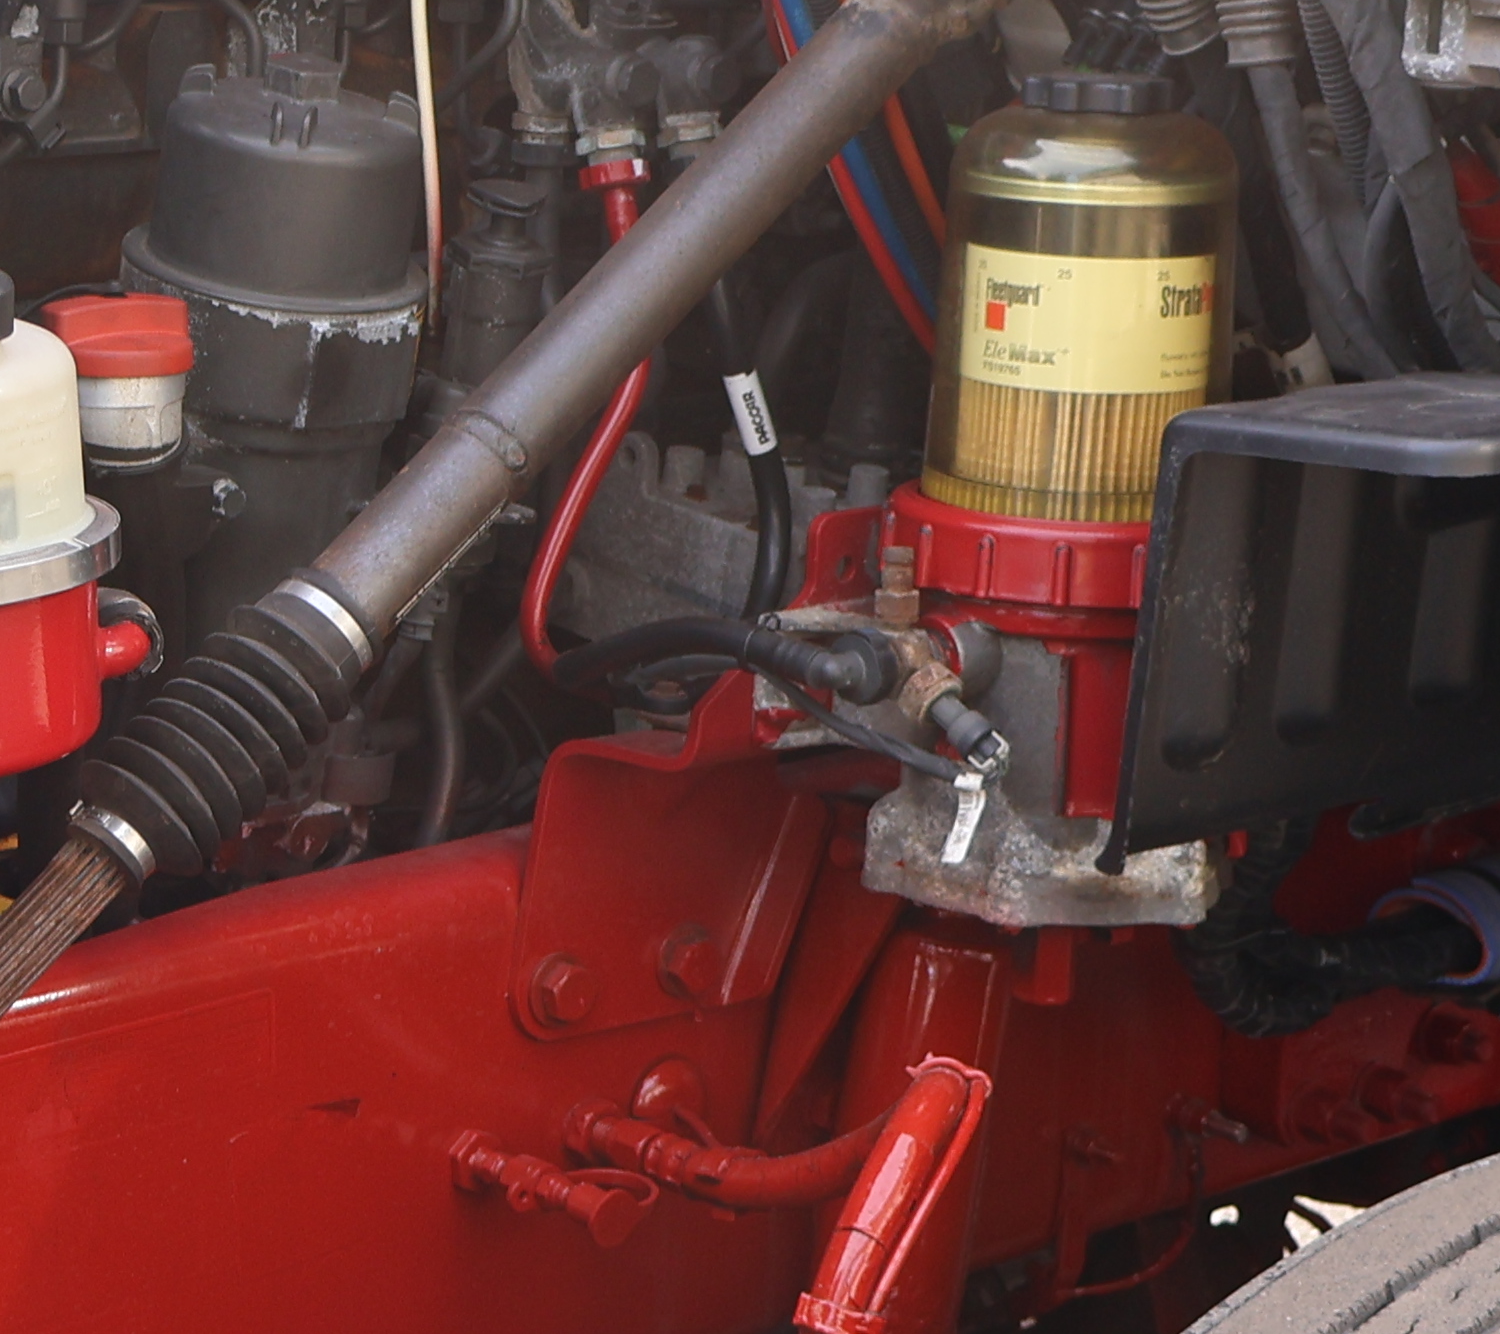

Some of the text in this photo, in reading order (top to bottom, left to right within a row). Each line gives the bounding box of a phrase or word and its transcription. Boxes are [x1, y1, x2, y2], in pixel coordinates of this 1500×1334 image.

[1057, 268, 1073, 281] 25
[1157, 270, 1171, 282] 25
[985, 277, 1042, 308] Fleetguard
[742, 390, 771, 445] PACCAR
